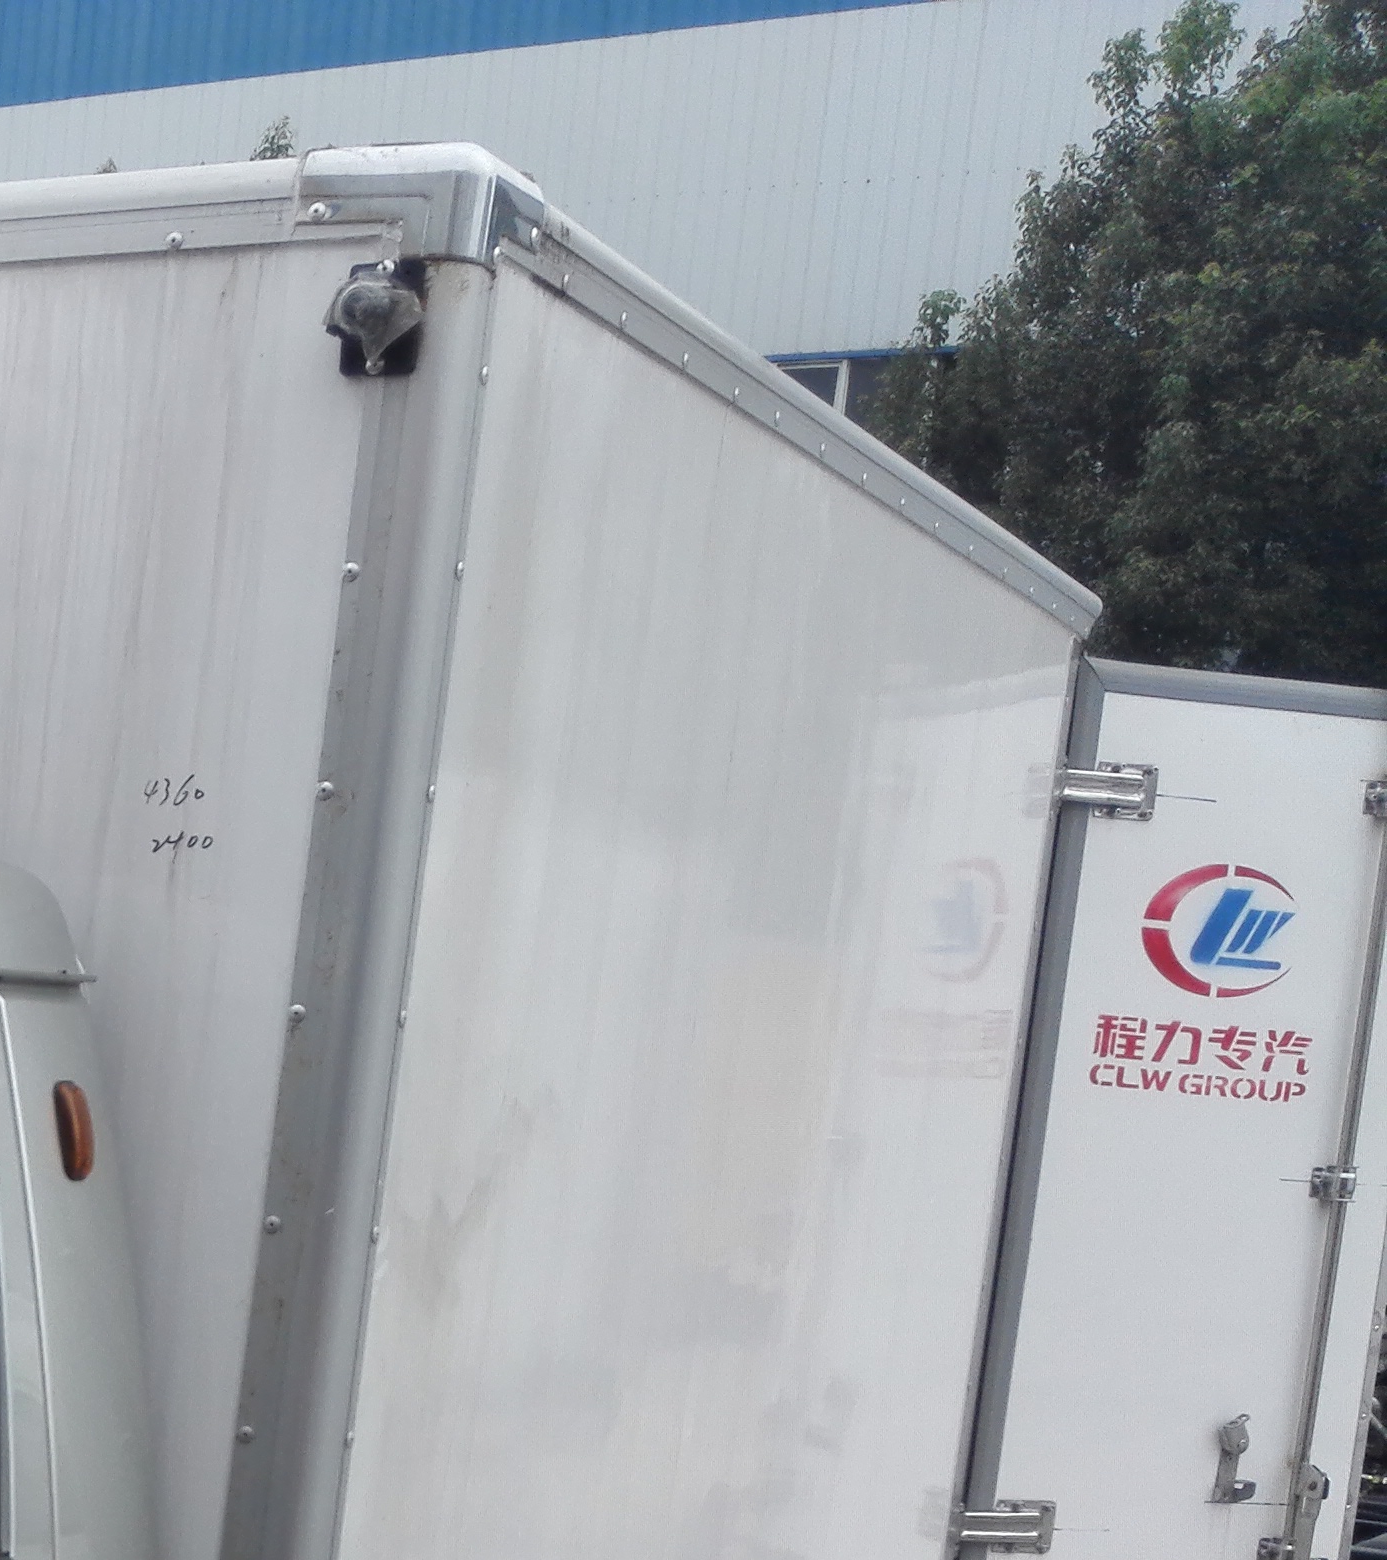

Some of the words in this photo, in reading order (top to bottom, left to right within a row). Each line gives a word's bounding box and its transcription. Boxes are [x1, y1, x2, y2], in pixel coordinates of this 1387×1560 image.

[1092, 1013, 1314, 1076] 程力专汽
[1088, 1064, 1172, 1093] CLW
[1178, 1073, 1307, 1104] GROUP
